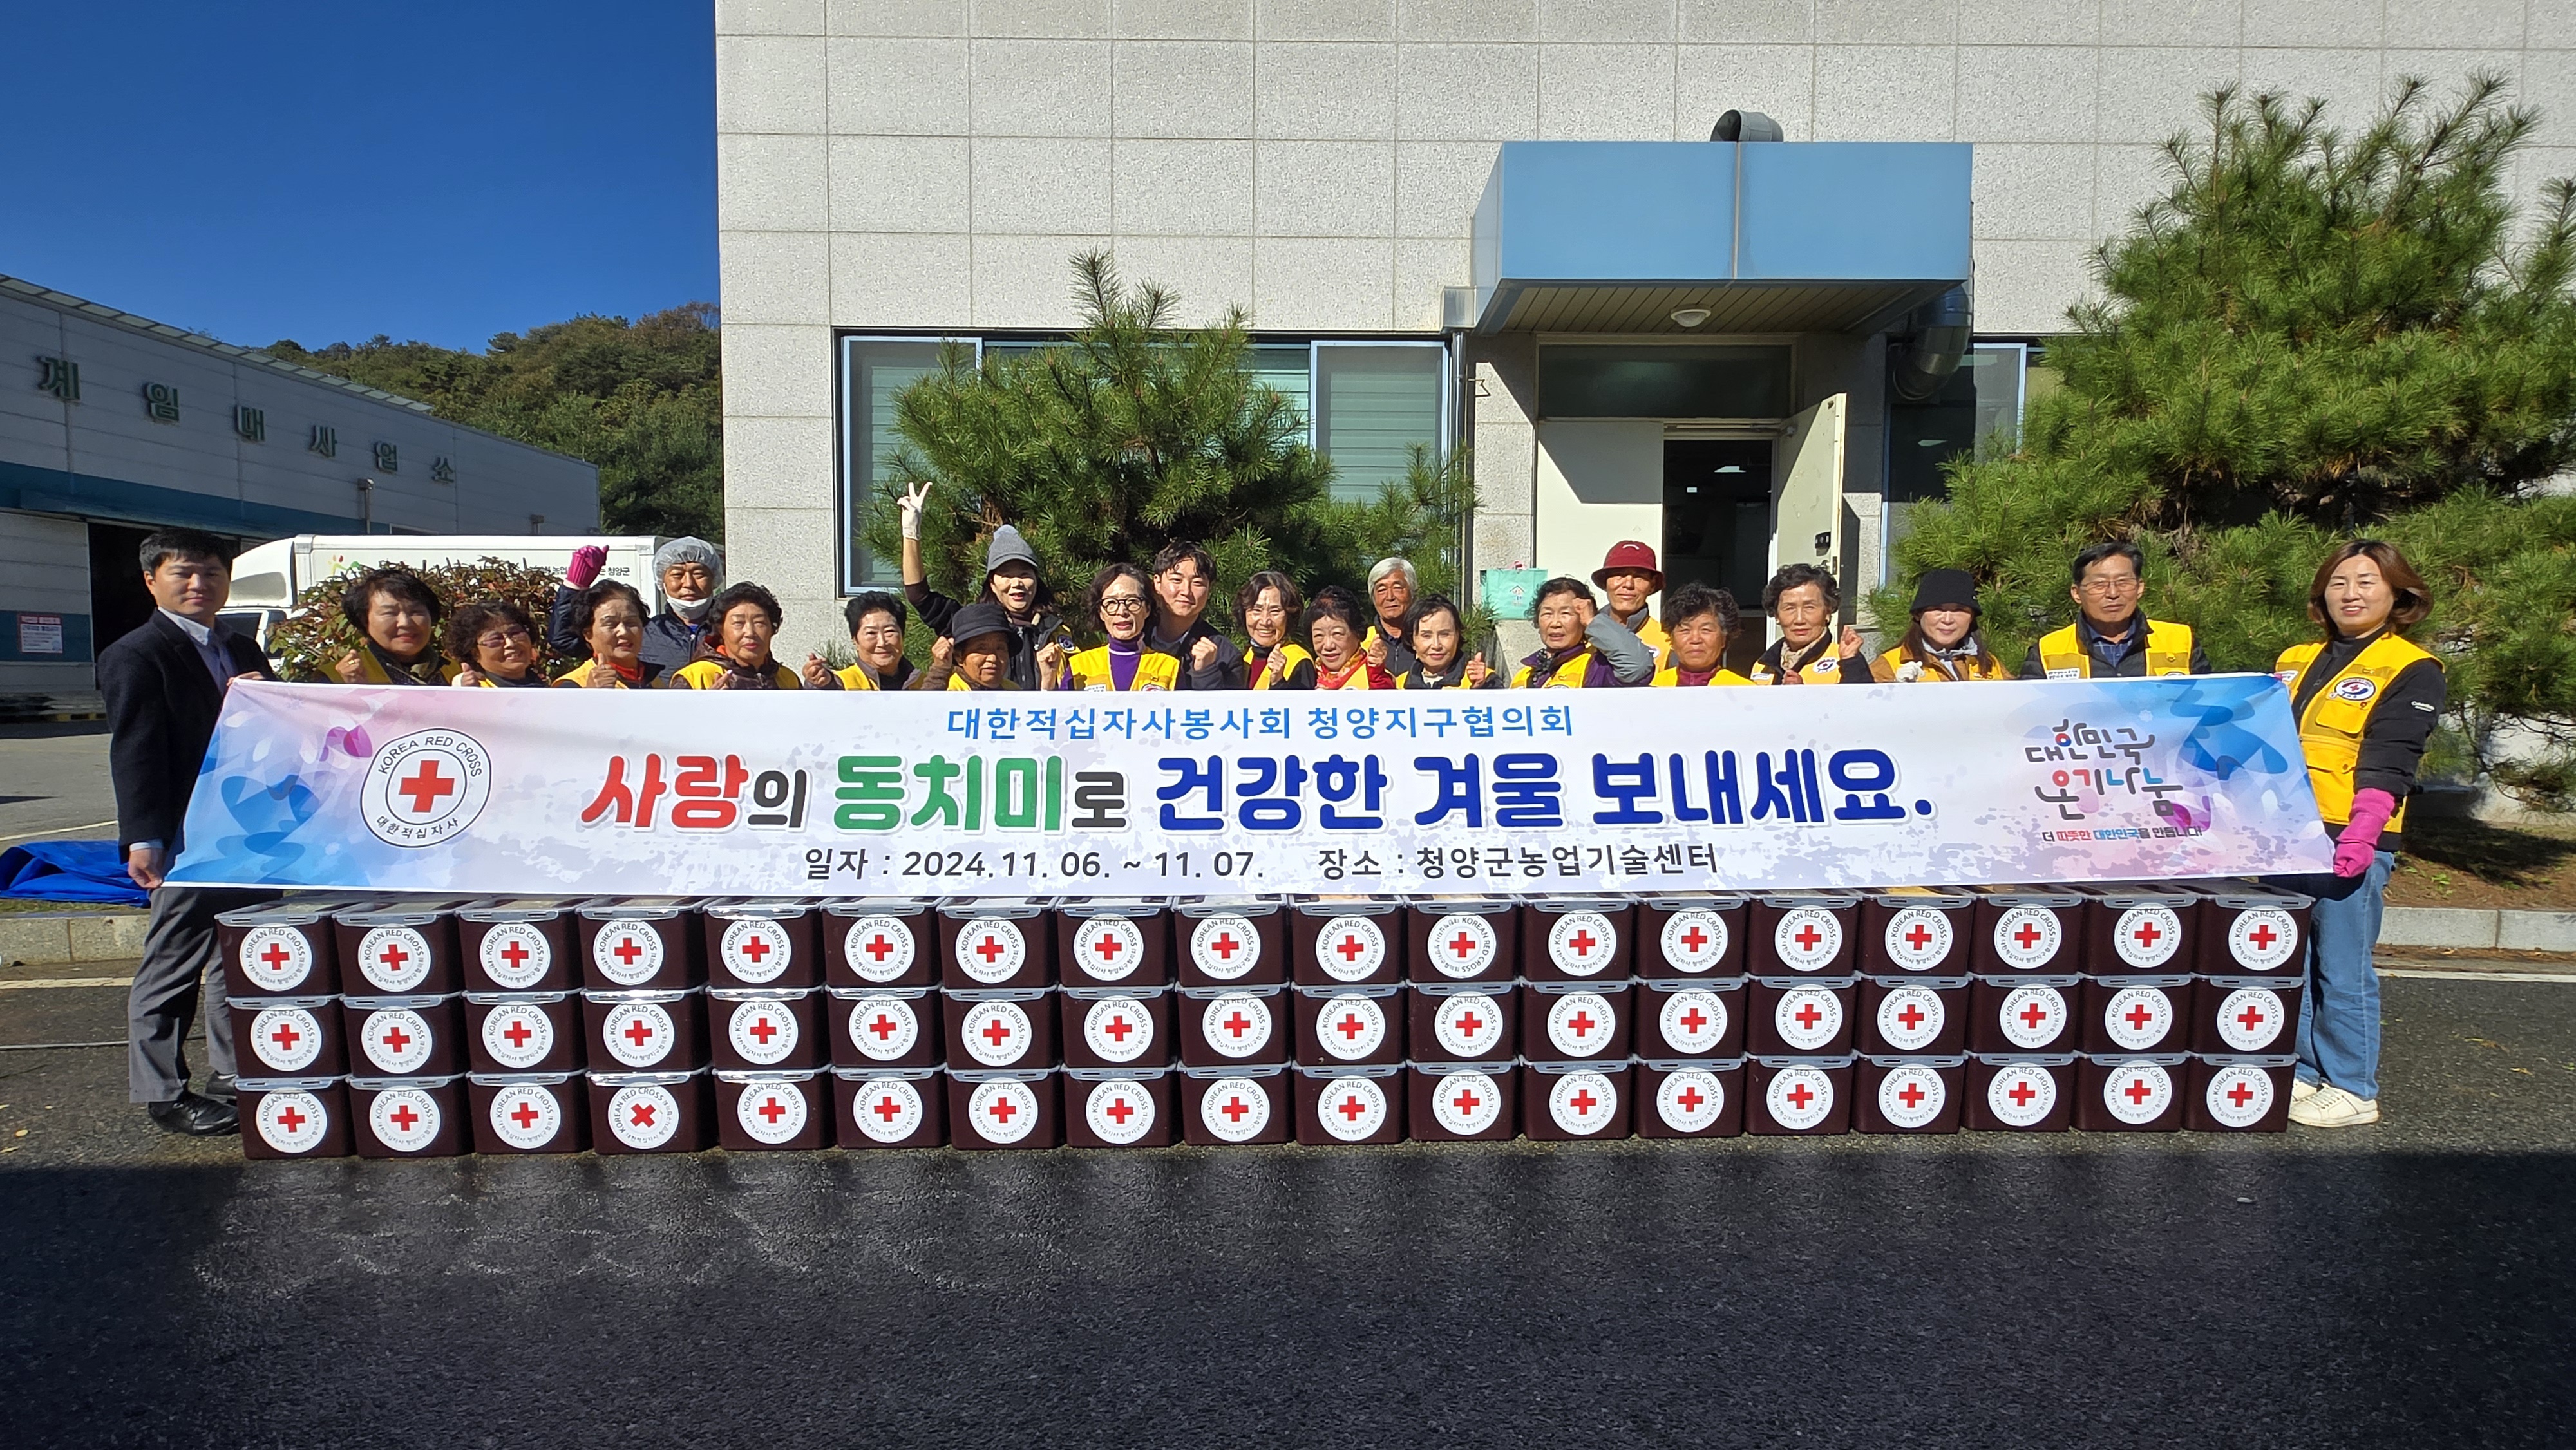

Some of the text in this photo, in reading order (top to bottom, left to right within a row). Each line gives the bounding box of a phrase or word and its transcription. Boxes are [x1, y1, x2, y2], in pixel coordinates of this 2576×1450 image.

[607, 567, 630, 576] 청양군
[948, 706, 1571, 740] 대한적십자사봉사회 청양지구협의회
[378, 736, 482, 777] KOREA RED CROSS
[2025, 719, 2155, 765] 대한민국
[582, 749, 1931, 830] 사랑의 동치미로 건강한 겨울 보내세요.
[2034, 767, 2183, 821] 온기나눔
[376, 817, 459, 839] 대한적십자사
[2042, 825, 2203, 842] 더 따뜻한 대한민국을 만듭니다!
[806, 849, 868, 879] 일자
[1319, 849, 1381, 880] 장소
[1417, 843, 1717, 878] 청양군농업기술센터
[726, 921, 785, 951] KOREAN RED CROSS
[849, 919, 909, 949] KOREAN RED CROSS
[960, 921, 1019, 951] KOREAN RED CROSS
[1079, 918, 1137, 948] KOREAN RED CROSS
[1196, 917, 1255, 948] KOREAN RED CROSS
[1321, 919, 1379, 950] KOREAN RED CROSS
[1553, 914, 1611, 945] KOREAN RED CROSS
[1666, 911, 1723, 941] KOREAN RED CROSS
[1780, 910, 1837, 939] KOREAN RED CROSS
[1891, 909, 1947, 939] KOREAN RED CROSS
[1999, 908, 2056, 937] KOREAN RED CROSS
[245, 928, 305, 959] KOREAN RED CROSS
[363, 929, 424, 961] KOREAN RED CROSS
[485, 926, 544, 956] KOREAN RED CROSS
[598, 923, 657, 953] KOREAN RED CROSS
[1461, 916, 1490, 973] KOREAN RED CROSS
[1089, 1001, 1148, 1031] KOREAN RED CROSS
[1440, 995, 1497, 1025] KOREAN RED CROSS
[1553, 996, 1610, 1025] KOREAN RED CROSS
[1665, 992, 1722, 1022] KOREAN RED CROSS
[1781, 988, 1837, 1017] KOREAN RED CROSS
[1882, 989, 1940, 1019] KOREAN RED CROSS
[2005, 987, 2061, 1017] KOREAN RED CROSS
[2222, 991, 2279, 1019] KOREAN RED CROSS
[366, 1013, 388, 1042] KOREAN
[406, 1016, 425, 1039] CROSS
[488, 1006, 547, 1037] KOREAN RED CROSS
[609, 1005, 668, 1035] KOREAN RED CROSS
[734, 1003, 792, 1032] KOREAN RED CROSS
[967, 1004, 1025, 1034] KOREAN RED CROSS
[1323, 1080, 1381, 1110] KOREAN RED CROSS
[1437, 1074, 1495, 1104] KOREAN RED CROSS
[1772, 1068, 1828, 1100] KOREAN RED CROSS
[1884, 1068, 1940, 1097] KOREAN RED CROSS
[1994, 1066, 2051, 1095] KOREAN RED CROSS
[495, 1088, 554, 1118] KOREAN RED CROSS
[613, 1087, 664, 1134] KOREAN RED CROSS
[858, 1081, 916, 1111] KOREAN RED CROSS
[974, 1082, 1032, 1112] KOREAN RED CROSS
[1091, 1083, 1149, 1113] KOREAN RED CROSS
[1206, 1081, 1264, 1111] KOREAN RED CROSS
